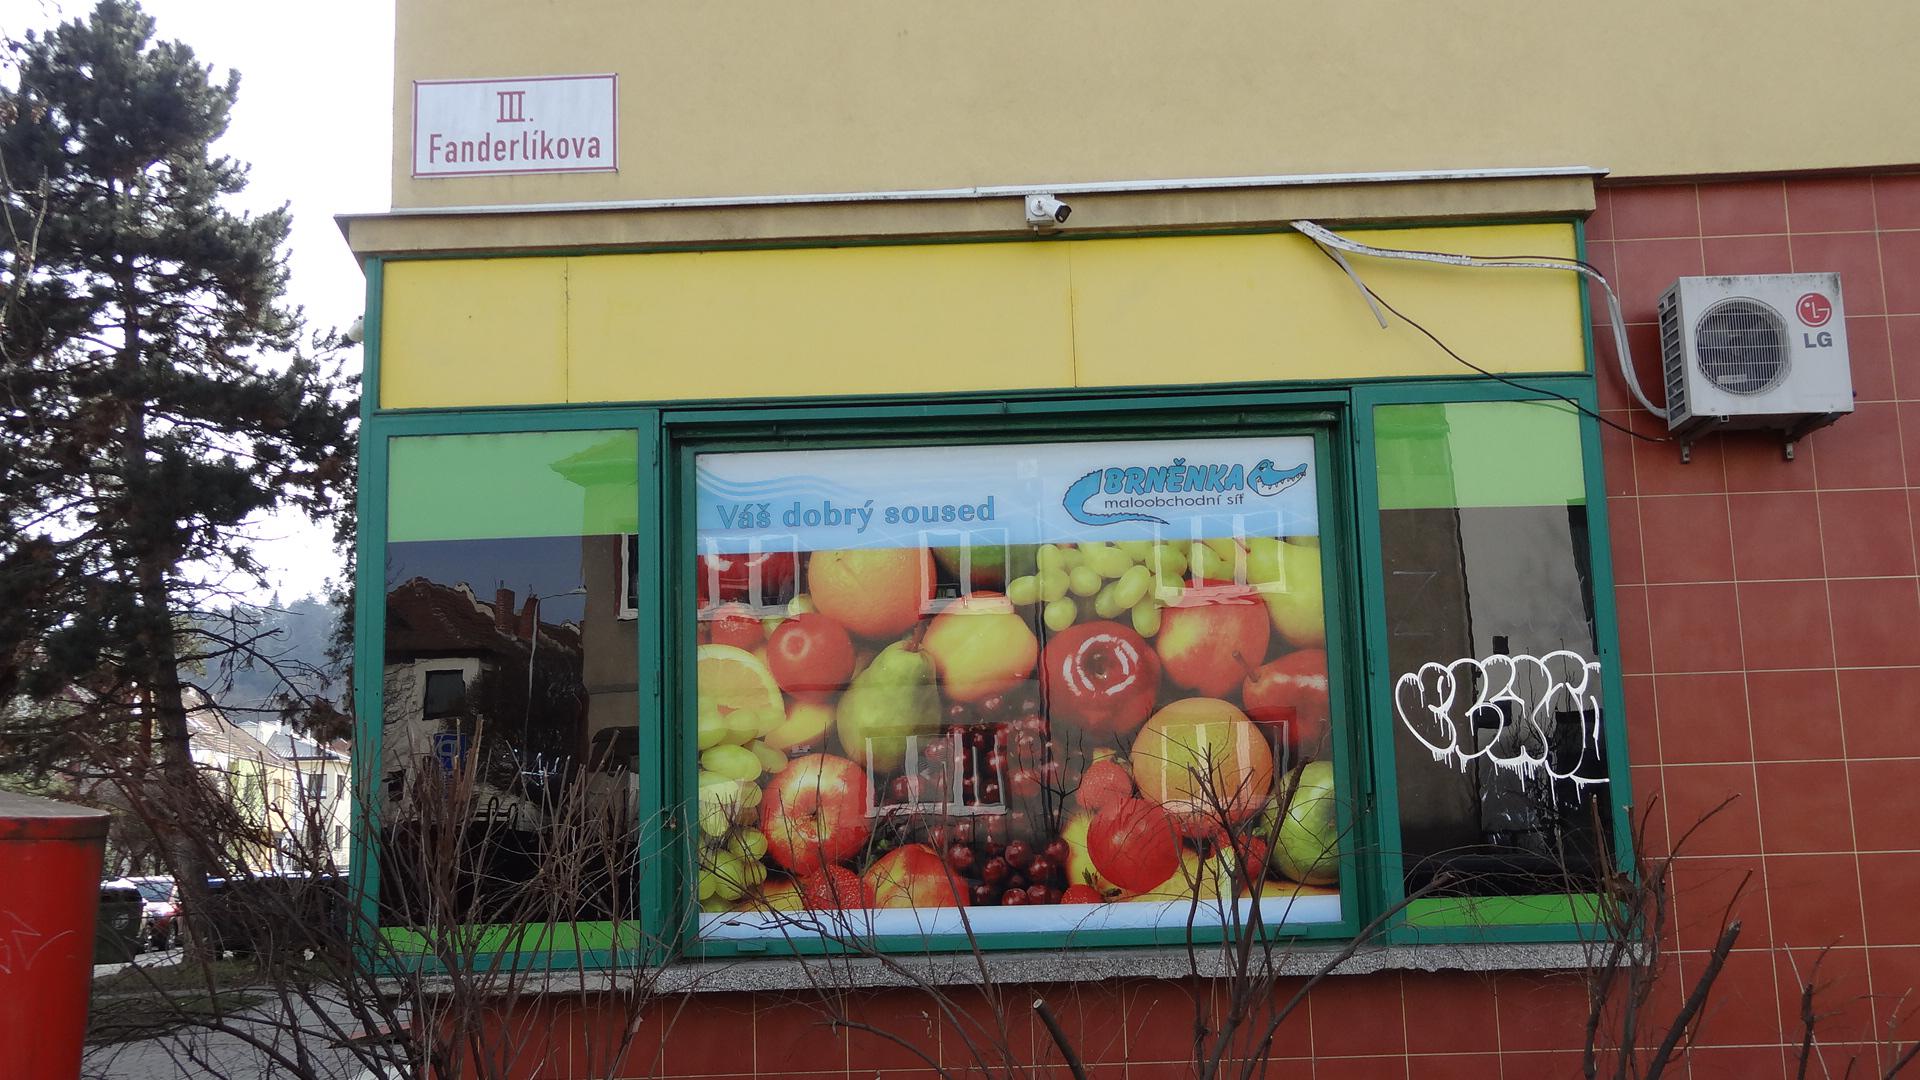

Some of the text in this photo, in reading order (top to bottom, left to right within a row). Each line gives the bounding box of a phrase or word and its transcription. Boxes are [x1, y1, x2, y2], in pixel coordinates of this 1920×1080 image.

[497, 91, 534, 123] III.
[429, 130, 601, 163] Fanderlíkova
[1803, 332, 1833, 348] LG
[1103, 458, 1245, 495] BRNĚNKA
[716, 496, 995, 533] Váš dobrý soused
[1104, 493, 1245, 509] maloobchodní síť
